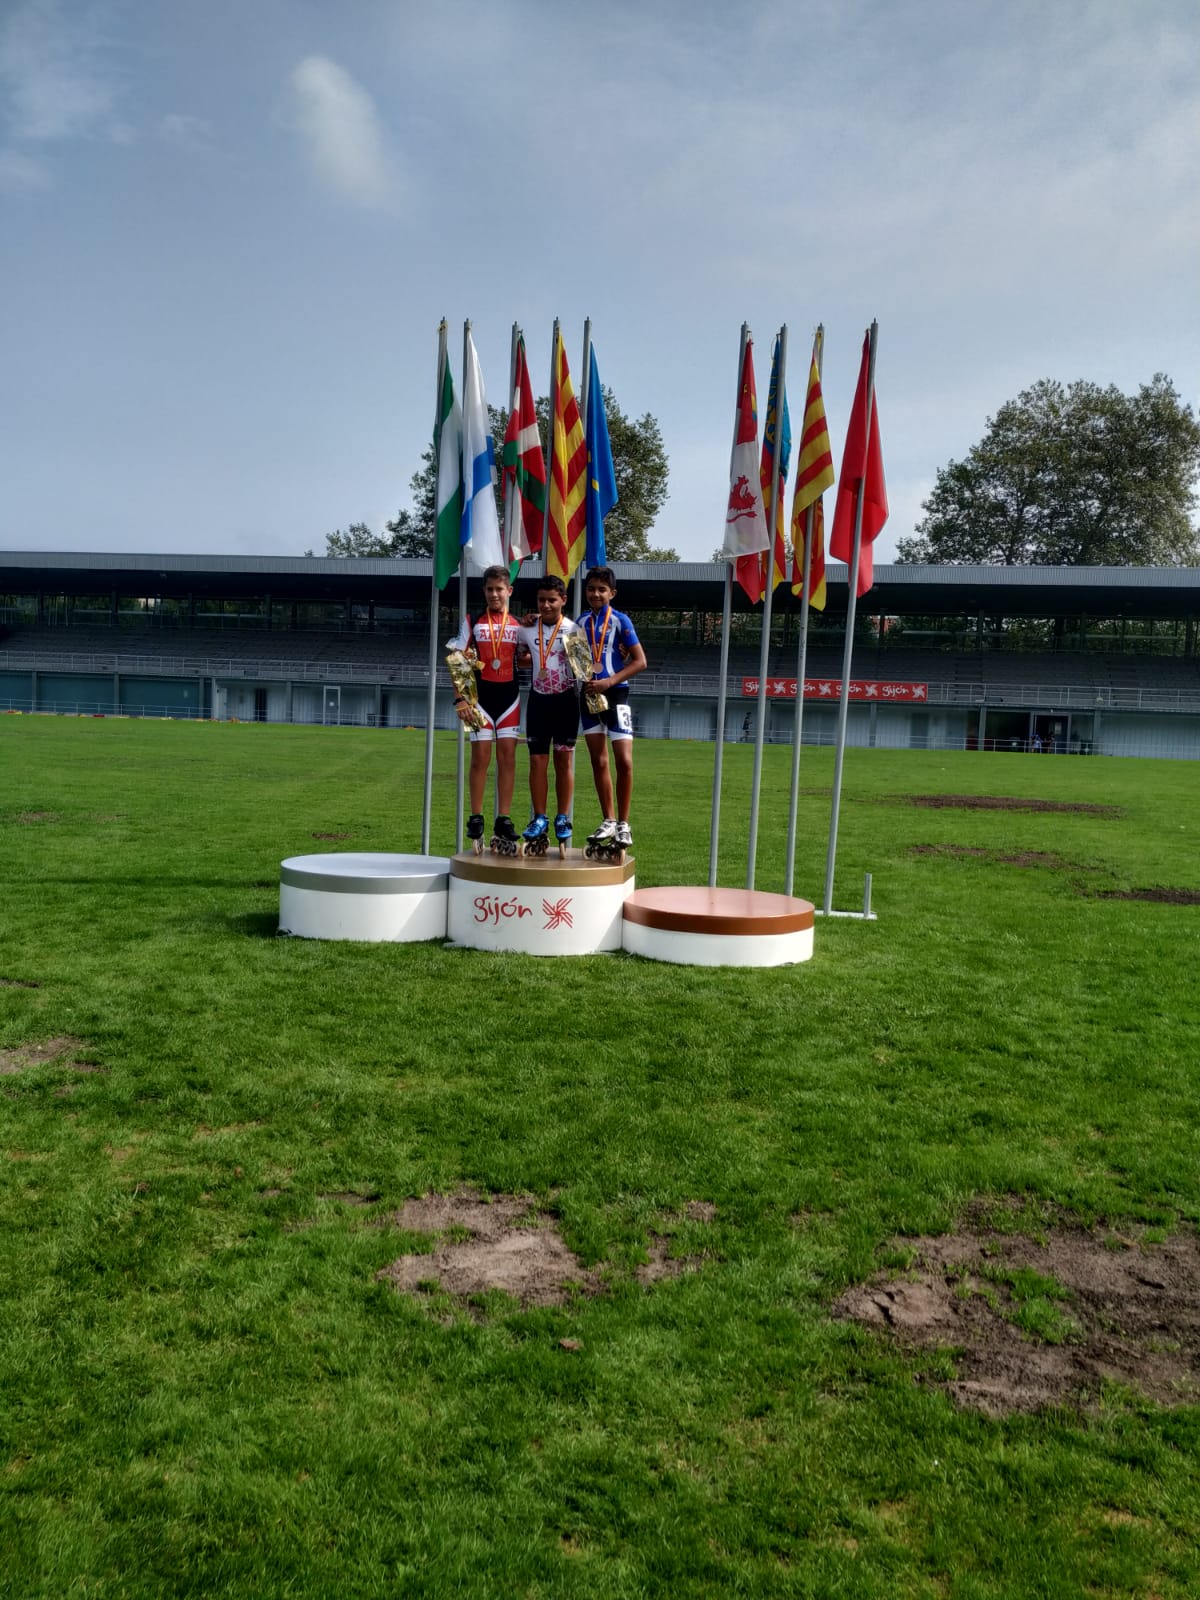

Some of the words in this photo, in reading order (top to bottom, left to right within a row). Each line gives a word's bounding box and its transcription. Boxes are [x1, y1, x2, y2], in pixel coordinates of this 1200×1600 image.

[790, 682, 816, 694] gón
[836, 683, 862, 696] gón
[882, 685, 909, 697] gijón
[473, 895, 533, 925] gijón
